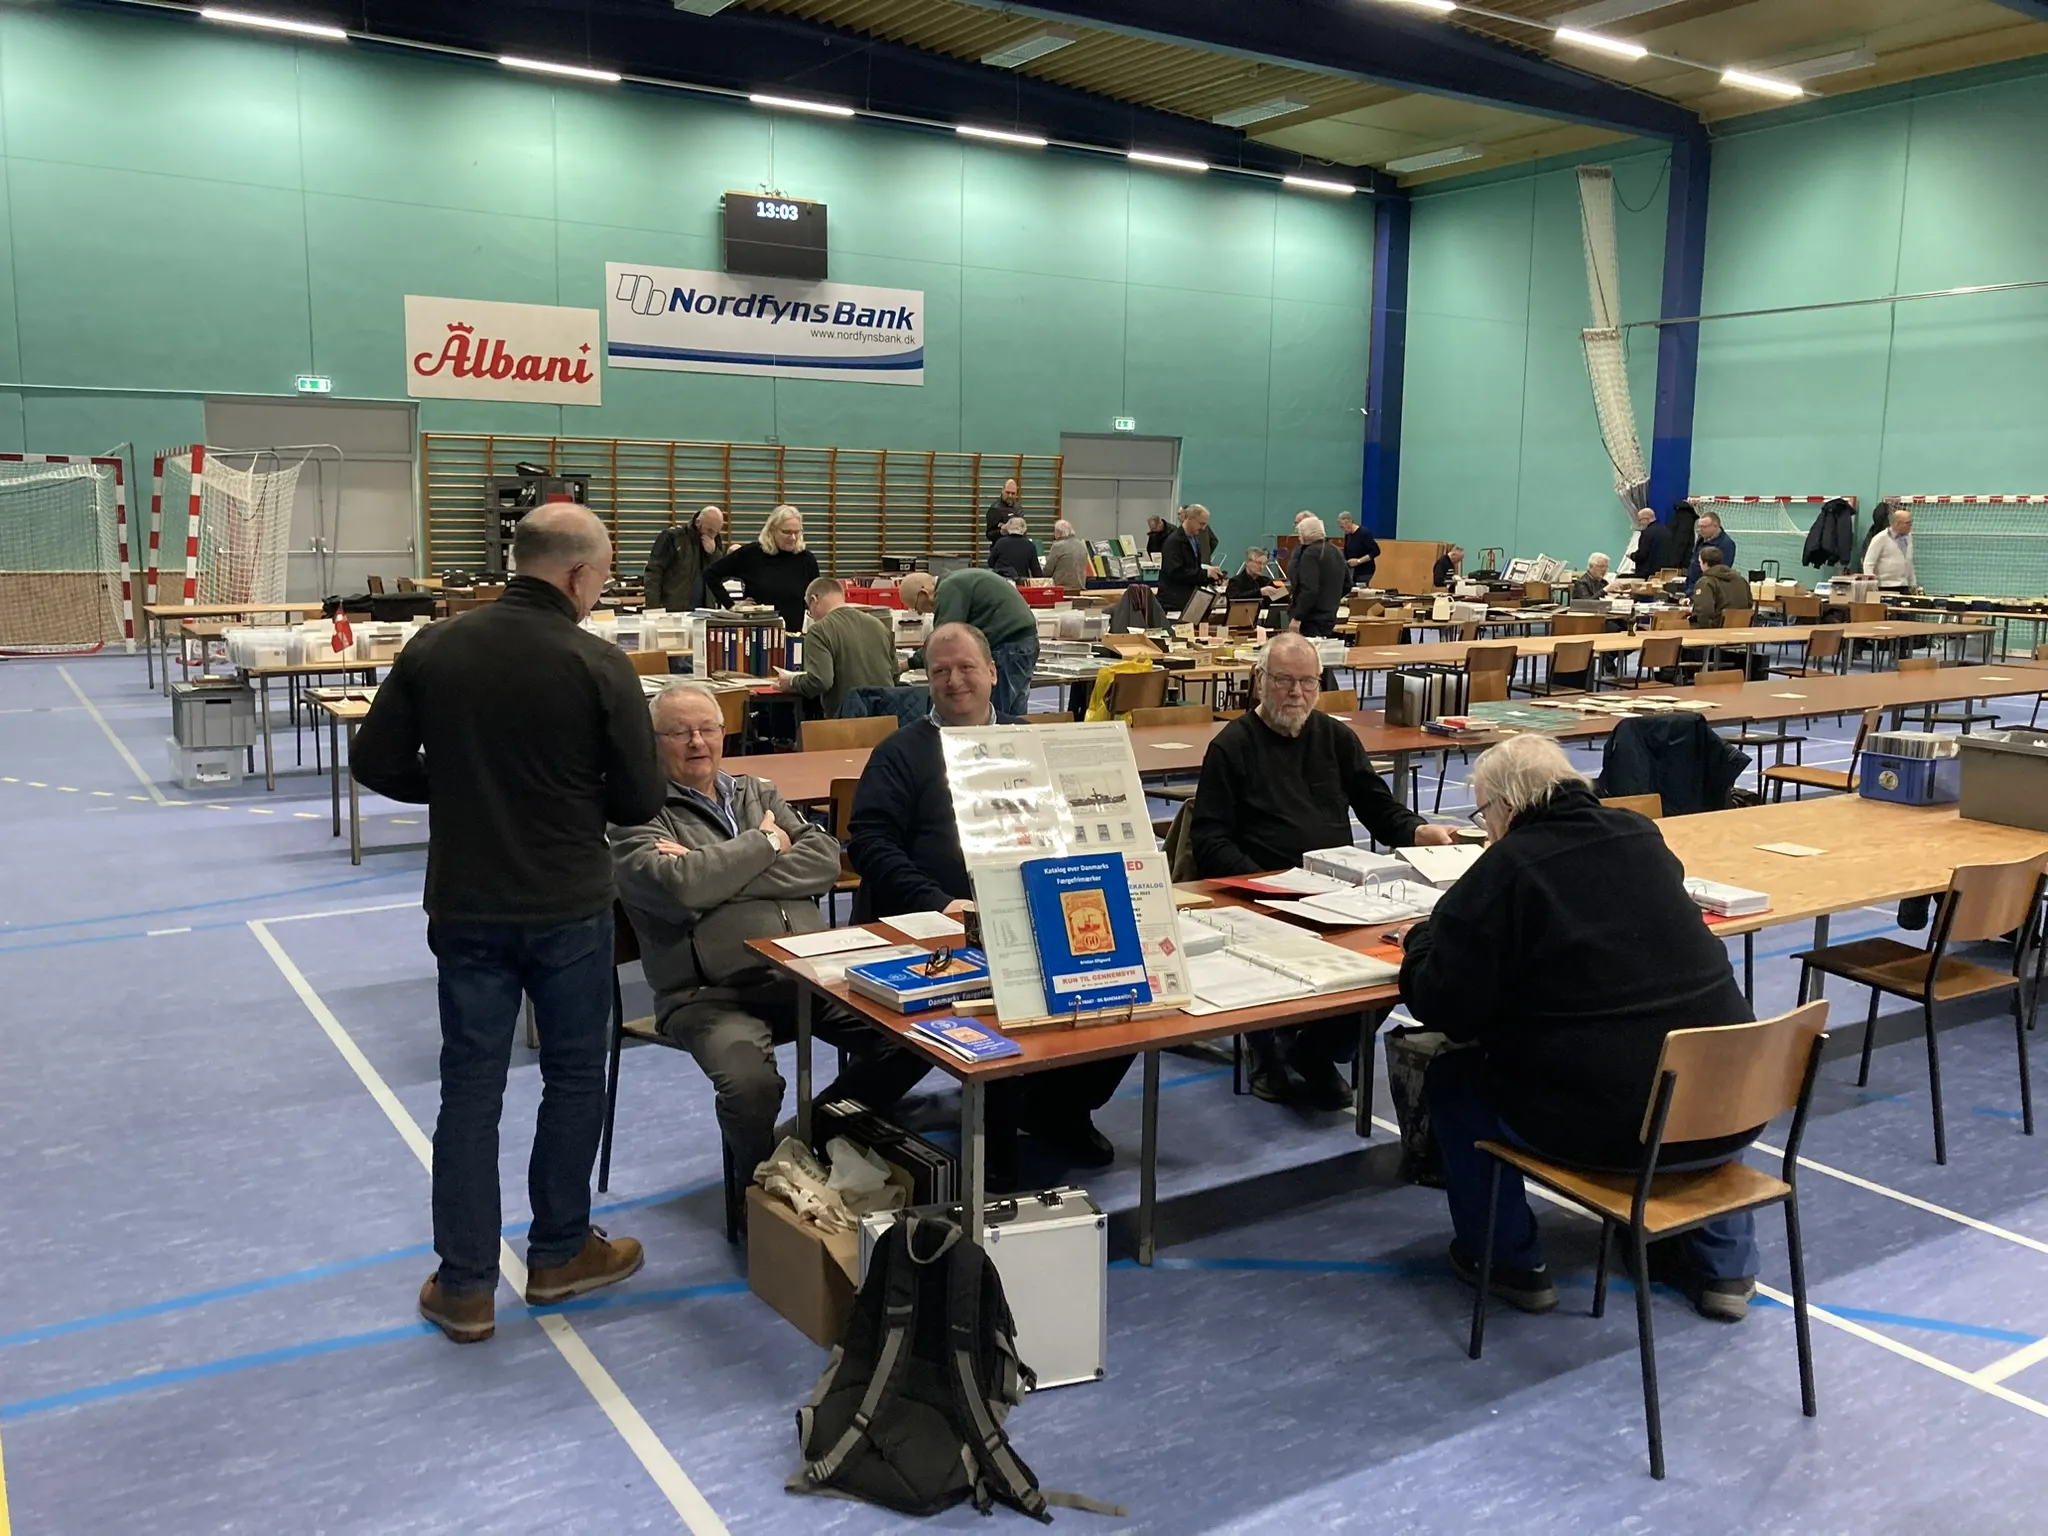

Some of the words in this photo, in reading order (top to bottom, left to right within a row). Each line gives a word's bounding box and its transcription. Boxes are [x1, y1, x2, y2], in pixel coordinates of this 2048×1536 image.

[756, 201, 799, 221] 13:03
[810, 329, 916, 345] www.nordfynsbank.dk
[414, 333, 594, 384] Albani
[1044, 866, 1067, 875] Katalog
[1080, 863, 1109, 872] Danmarks
[1062, 977, 1078, 985] KUN
[1092, 969, 1136, 981] GENNEMSYN
[928, 994, 960, 1007] Danmarks
